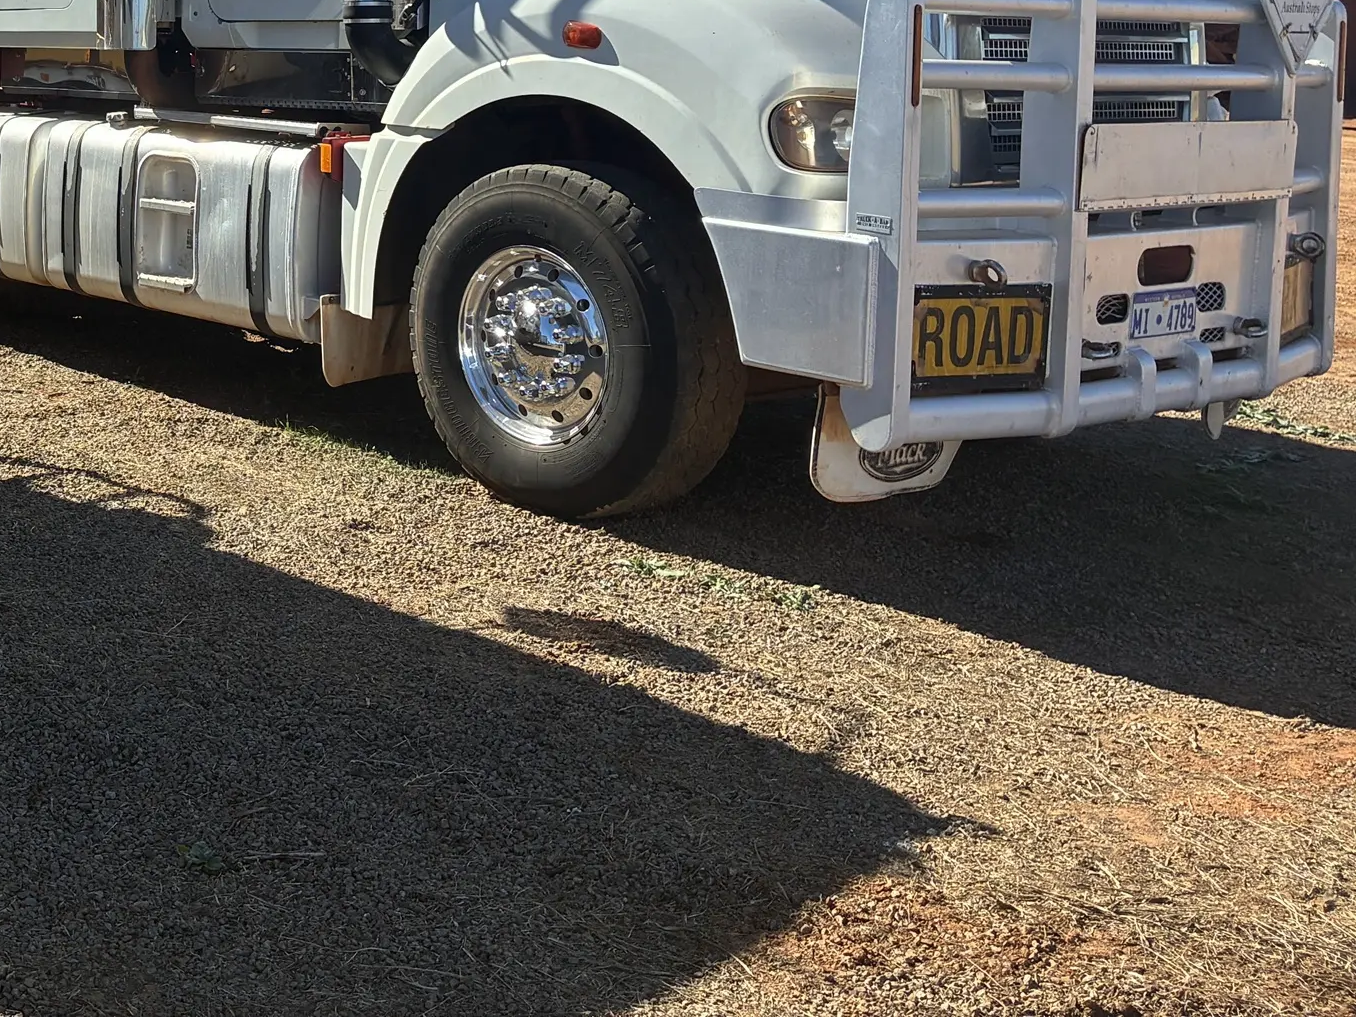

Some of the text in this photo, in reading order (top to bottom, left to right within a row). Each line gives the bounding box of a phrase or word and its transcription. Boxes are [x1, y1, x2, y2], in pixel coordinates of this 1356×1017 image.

[1281, 1, 1305, 14] Austral
[1166, 301, 1195, 331] 4789
[918, 305, 1034, 368] ROAD
